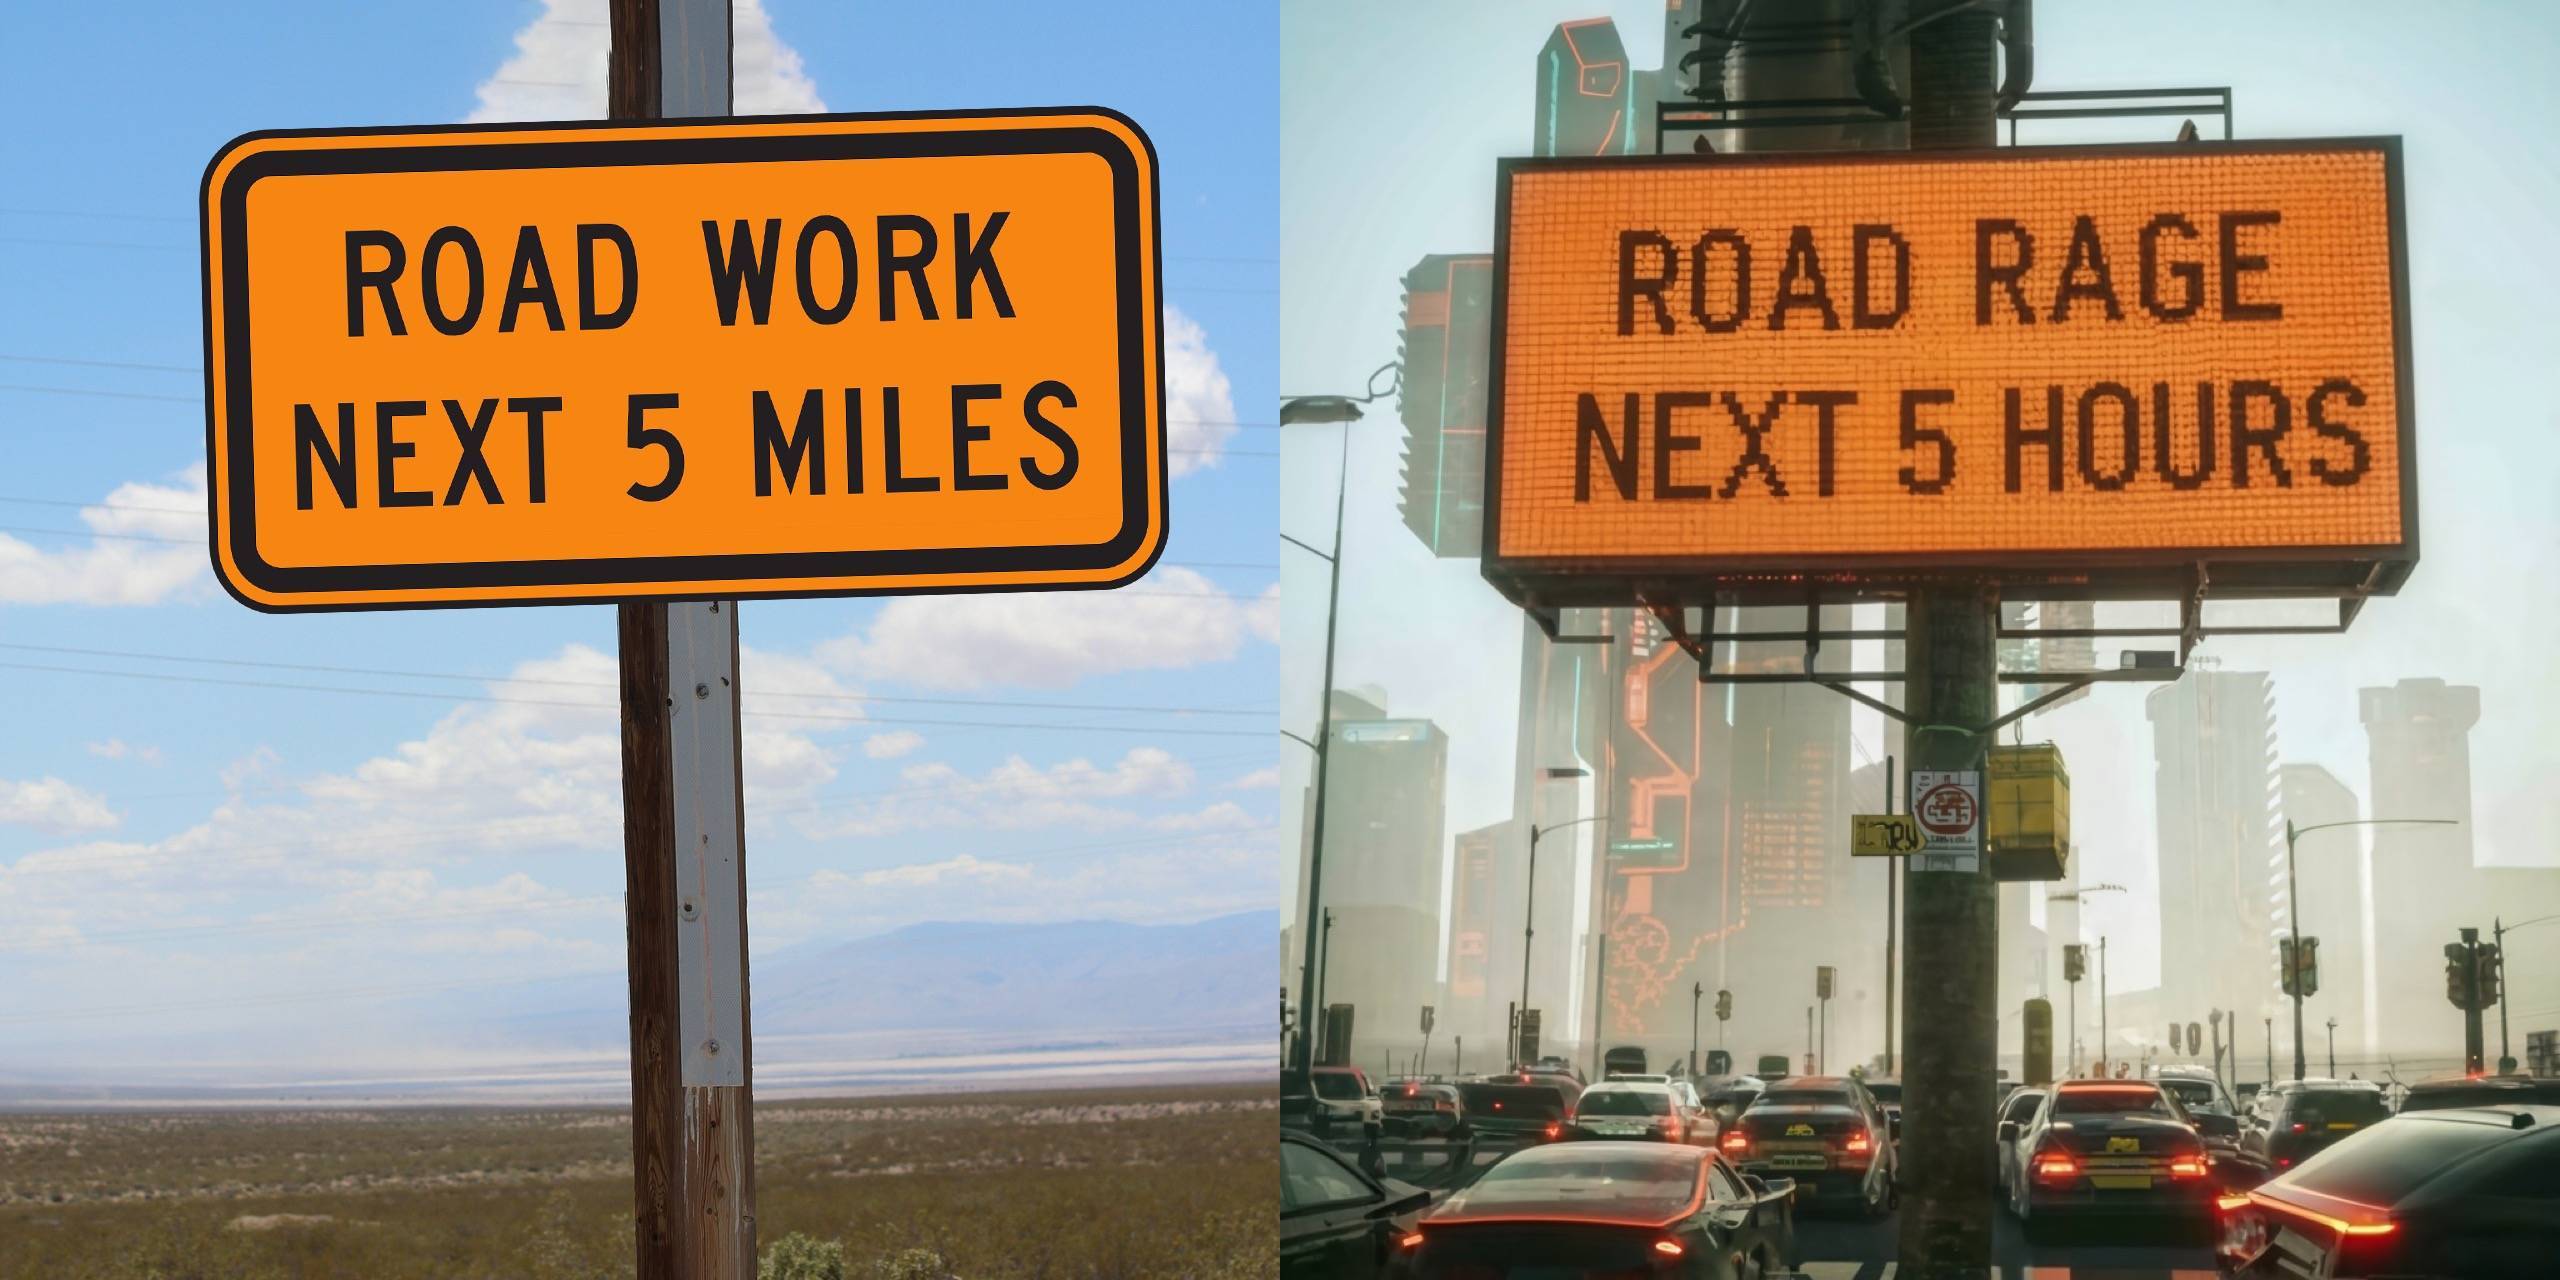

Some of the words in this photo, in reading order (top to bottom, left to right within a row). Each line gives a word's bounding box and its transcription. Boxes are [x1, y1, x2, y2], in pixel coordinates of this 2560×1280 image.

[346, 224, 638, 337] ROAD
[702, 212, 1016, 326] WORK
[1617, 224, 1912, 336] ROAD
[1975, 211, 2283, 326] RAGE
[294, 397, 562, 510] NEXT
[627, 393, 684, 502] 5
[753, 380, 1079, 496] MILES
[1574, 391, 1857, 502] NEXT
[1899, 389, 1956, 495] 5
[2005, 377, 2371, 493] HOURS
